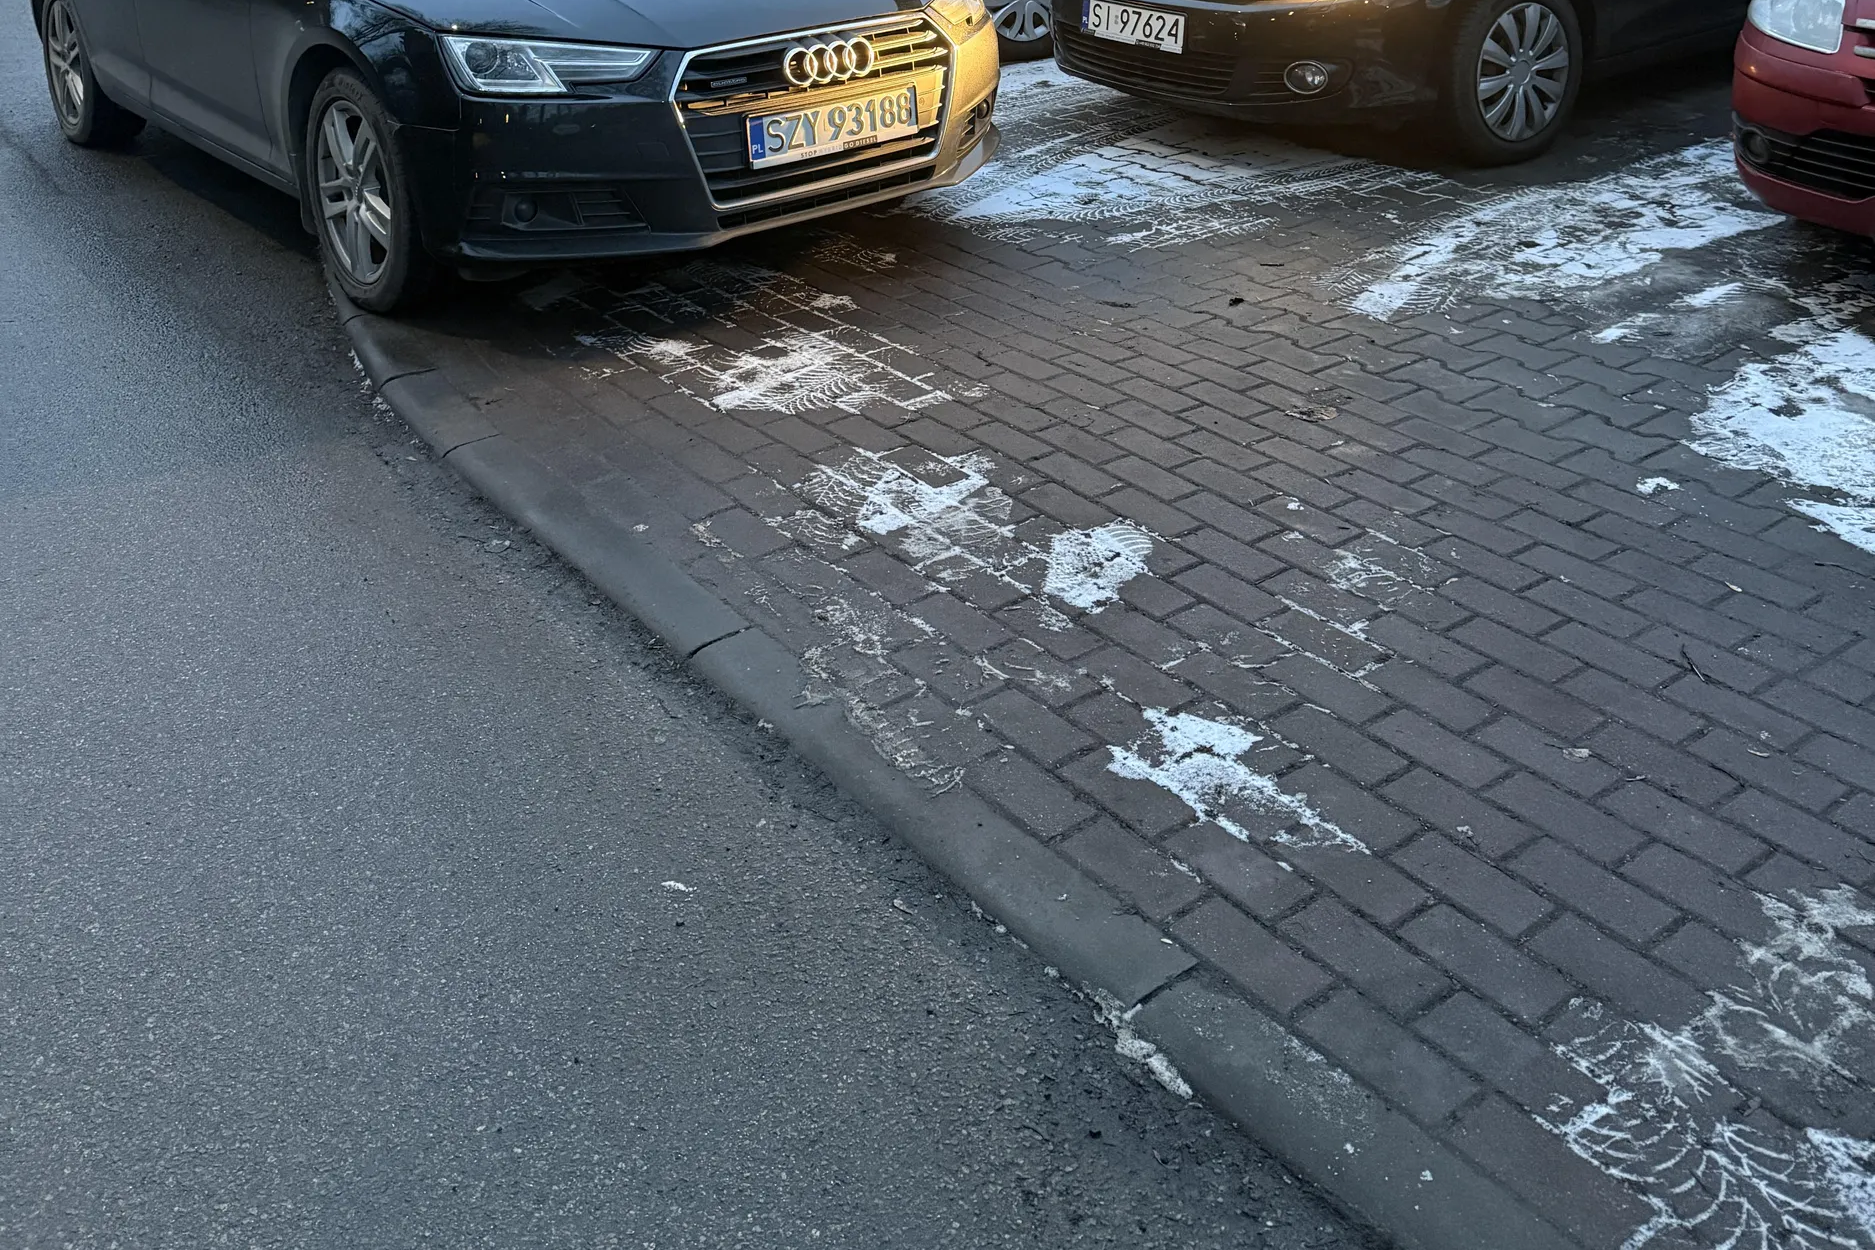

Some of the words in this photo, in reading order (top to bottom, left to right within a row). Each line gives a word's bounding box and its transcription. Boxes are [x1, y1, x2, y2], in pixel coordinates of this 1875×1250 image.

[1082, 16, 1089, 24] PL
[1092, 3, 1110, 31] SI
[1119, 8, 1180, 45] 97624
[752, 144, 764, 155] PL
[766, 110, 821, 153] SZY
[827, 93, 912, 142] 93188
[800, 150, 818, 159] STOP
[844, 141, 854, 149] GO
[855, 136, 877, 147] DIESEL
